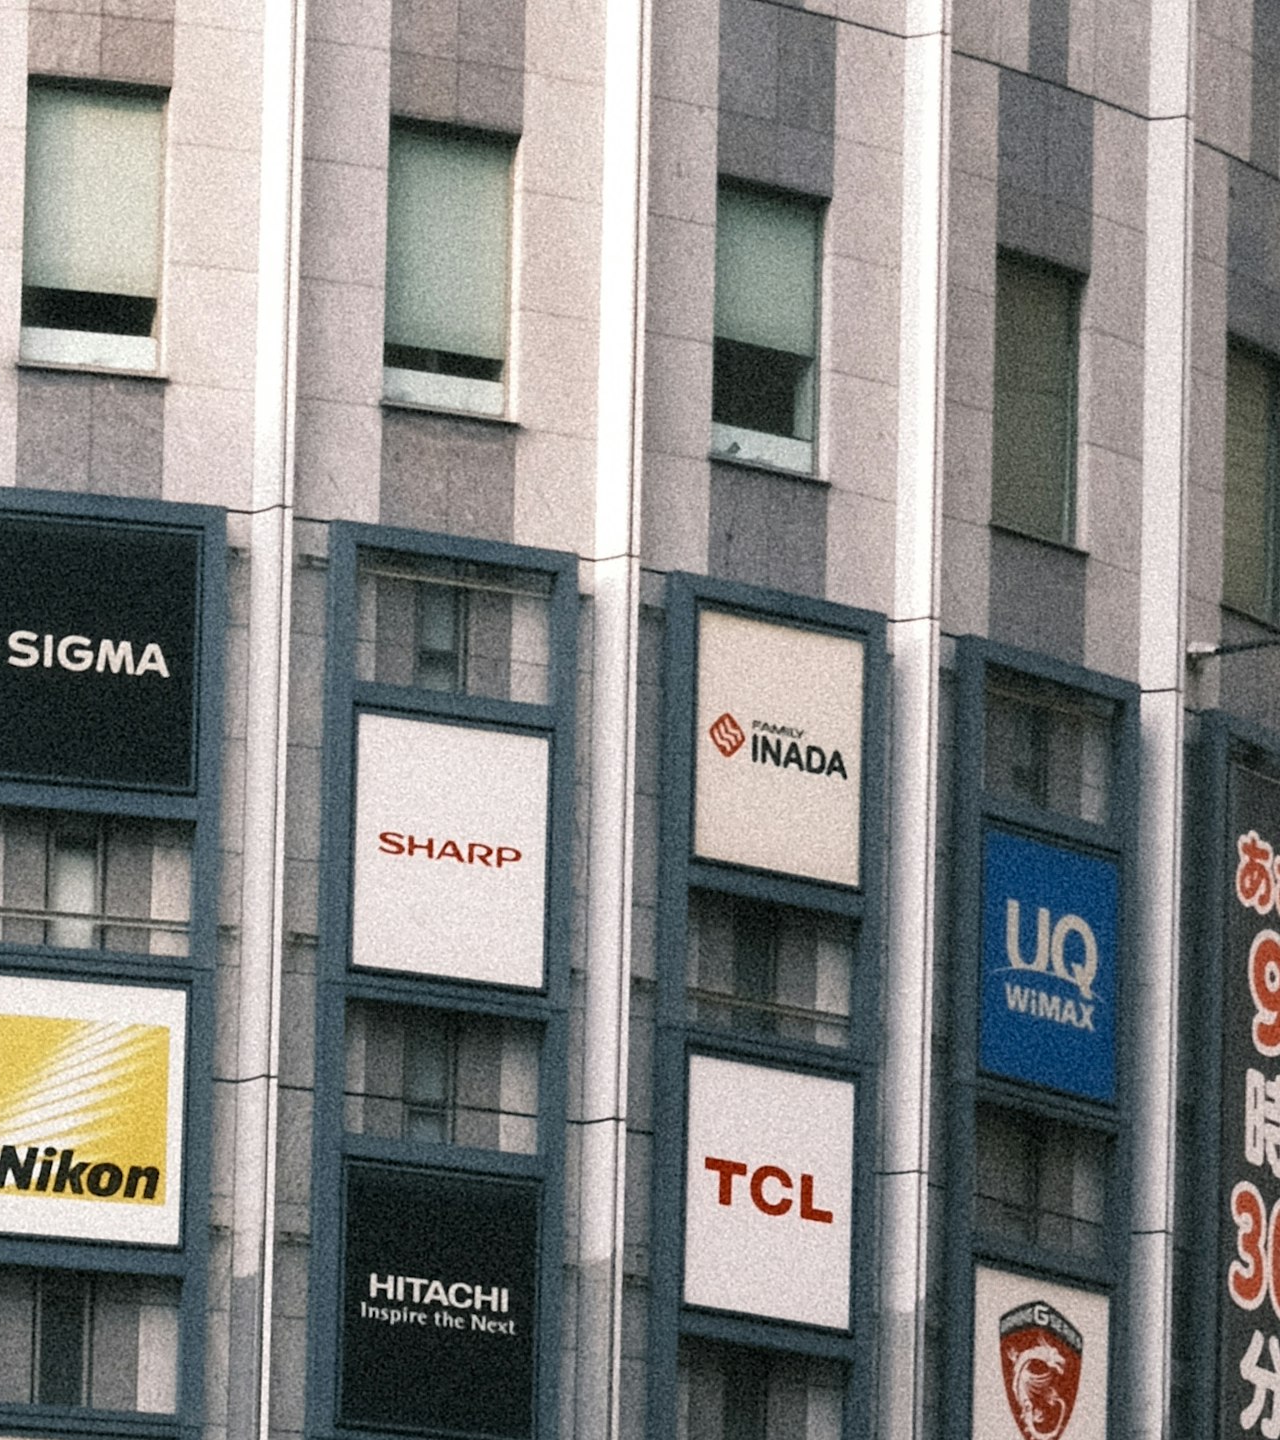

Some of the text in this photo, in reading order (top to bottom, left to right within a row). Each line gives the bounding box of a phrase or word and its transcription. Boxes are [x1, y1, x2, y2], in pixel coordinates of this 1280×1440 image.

[7, 630, 171, 679] SIGMA
[752, 720, 804, 738] FAMILY
[752, 733, 847, 780] INADA
[378, 832, 522, 869] SHARP
[1005, 898, 1099, 990] UQ
[1005, 983, 1096, 1033] WiMAX
[704, 1156, 833, 1225] TCL
[369, 1273, 509, 1313] HITACHI
[361, 1301, 516, 1335] Inspire the Next
